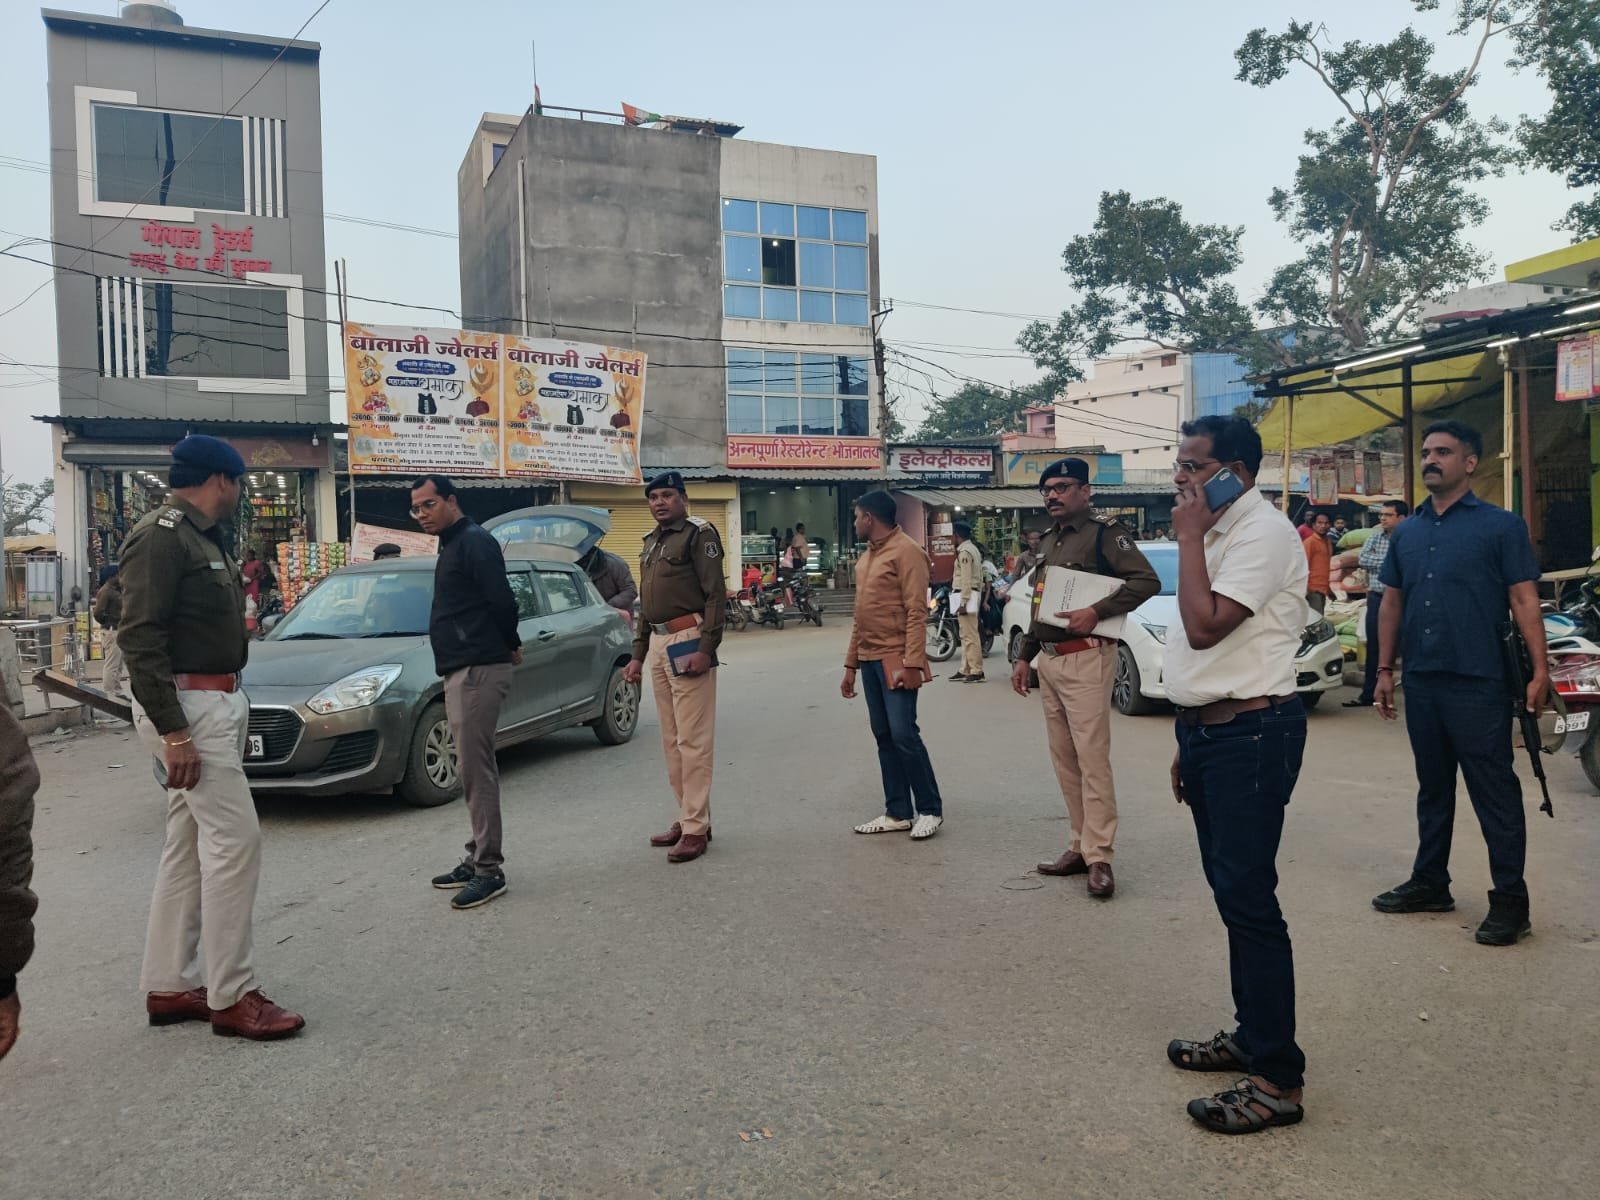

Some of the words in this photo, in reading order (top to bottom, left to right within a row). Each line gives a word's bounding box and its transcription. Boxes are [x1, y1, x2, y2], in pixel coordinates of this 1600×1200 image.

[350, 334, 430, 354] बालाजी
[435, 337, 500, 360] ज्वेलर्स
[507, 349, 580, 368] बालाजी
[584, 352, 641, 376] ज्वेलर्स
[729, 438, 779, 462] अन्नपूर्णा
[781, 438, 828, 459] रेस्टोरेन्ट
[832, 441, 880, 460] भोजनालय
[899, 448, 992, 469] इलेक्ट्रीकल्स
